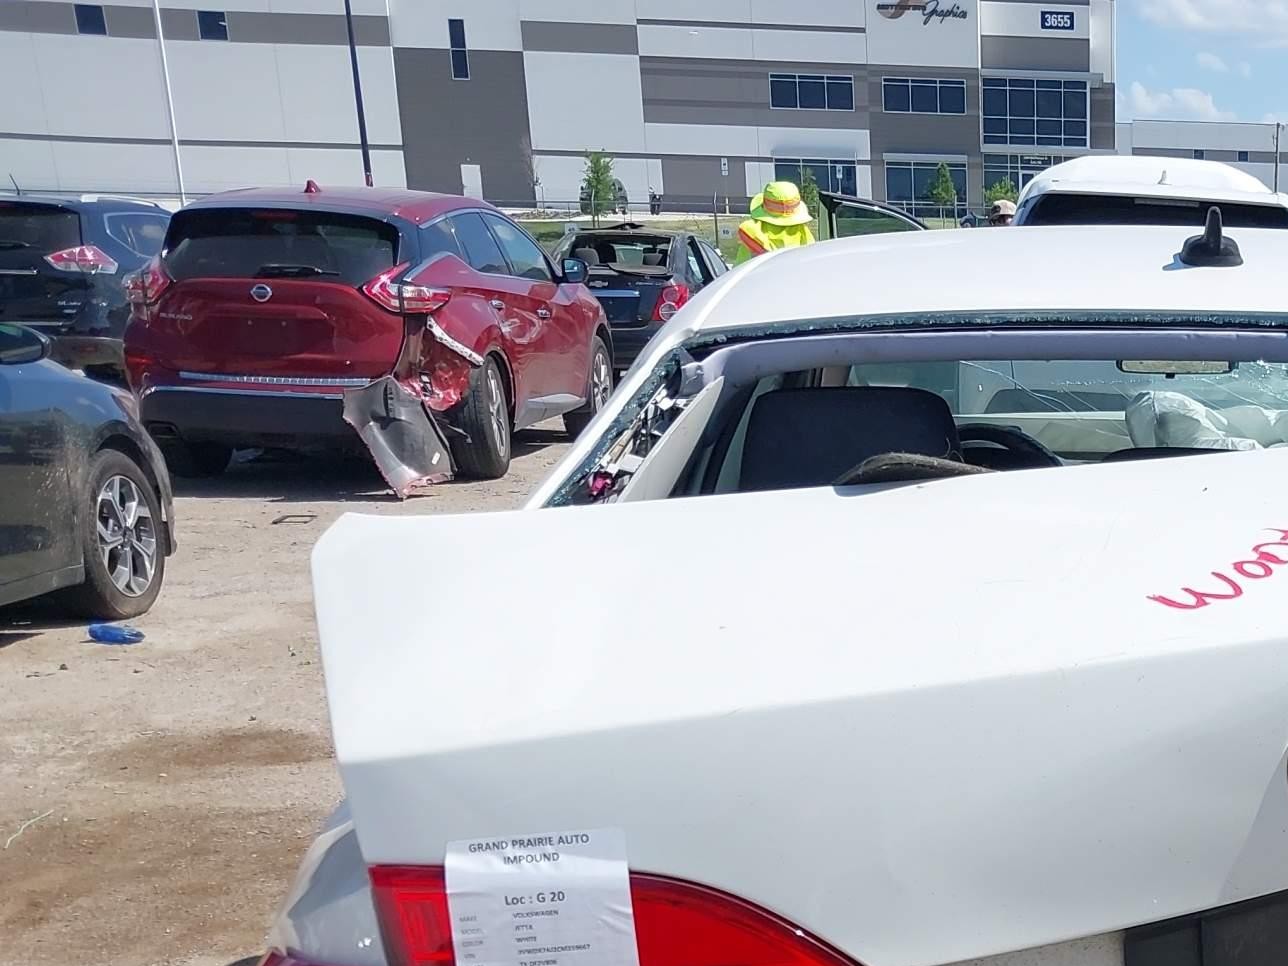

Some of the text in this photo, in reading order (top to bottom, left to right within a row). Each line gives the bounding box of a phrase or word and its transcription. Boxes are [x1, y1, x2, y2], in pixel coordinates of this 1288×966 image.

[1044, 14, 1071, 28] 3655
[468, 833, 590, 853] GRAND PRAIRIE AUTO
[503, 852, 560, 866] IMPOUND
[504, 895, 526, 906] Loc
[536, 892, 546, 904] G
[549, 890, 566, 903] 20
[512, 909, 560, 920] VOLKSWAGEN
